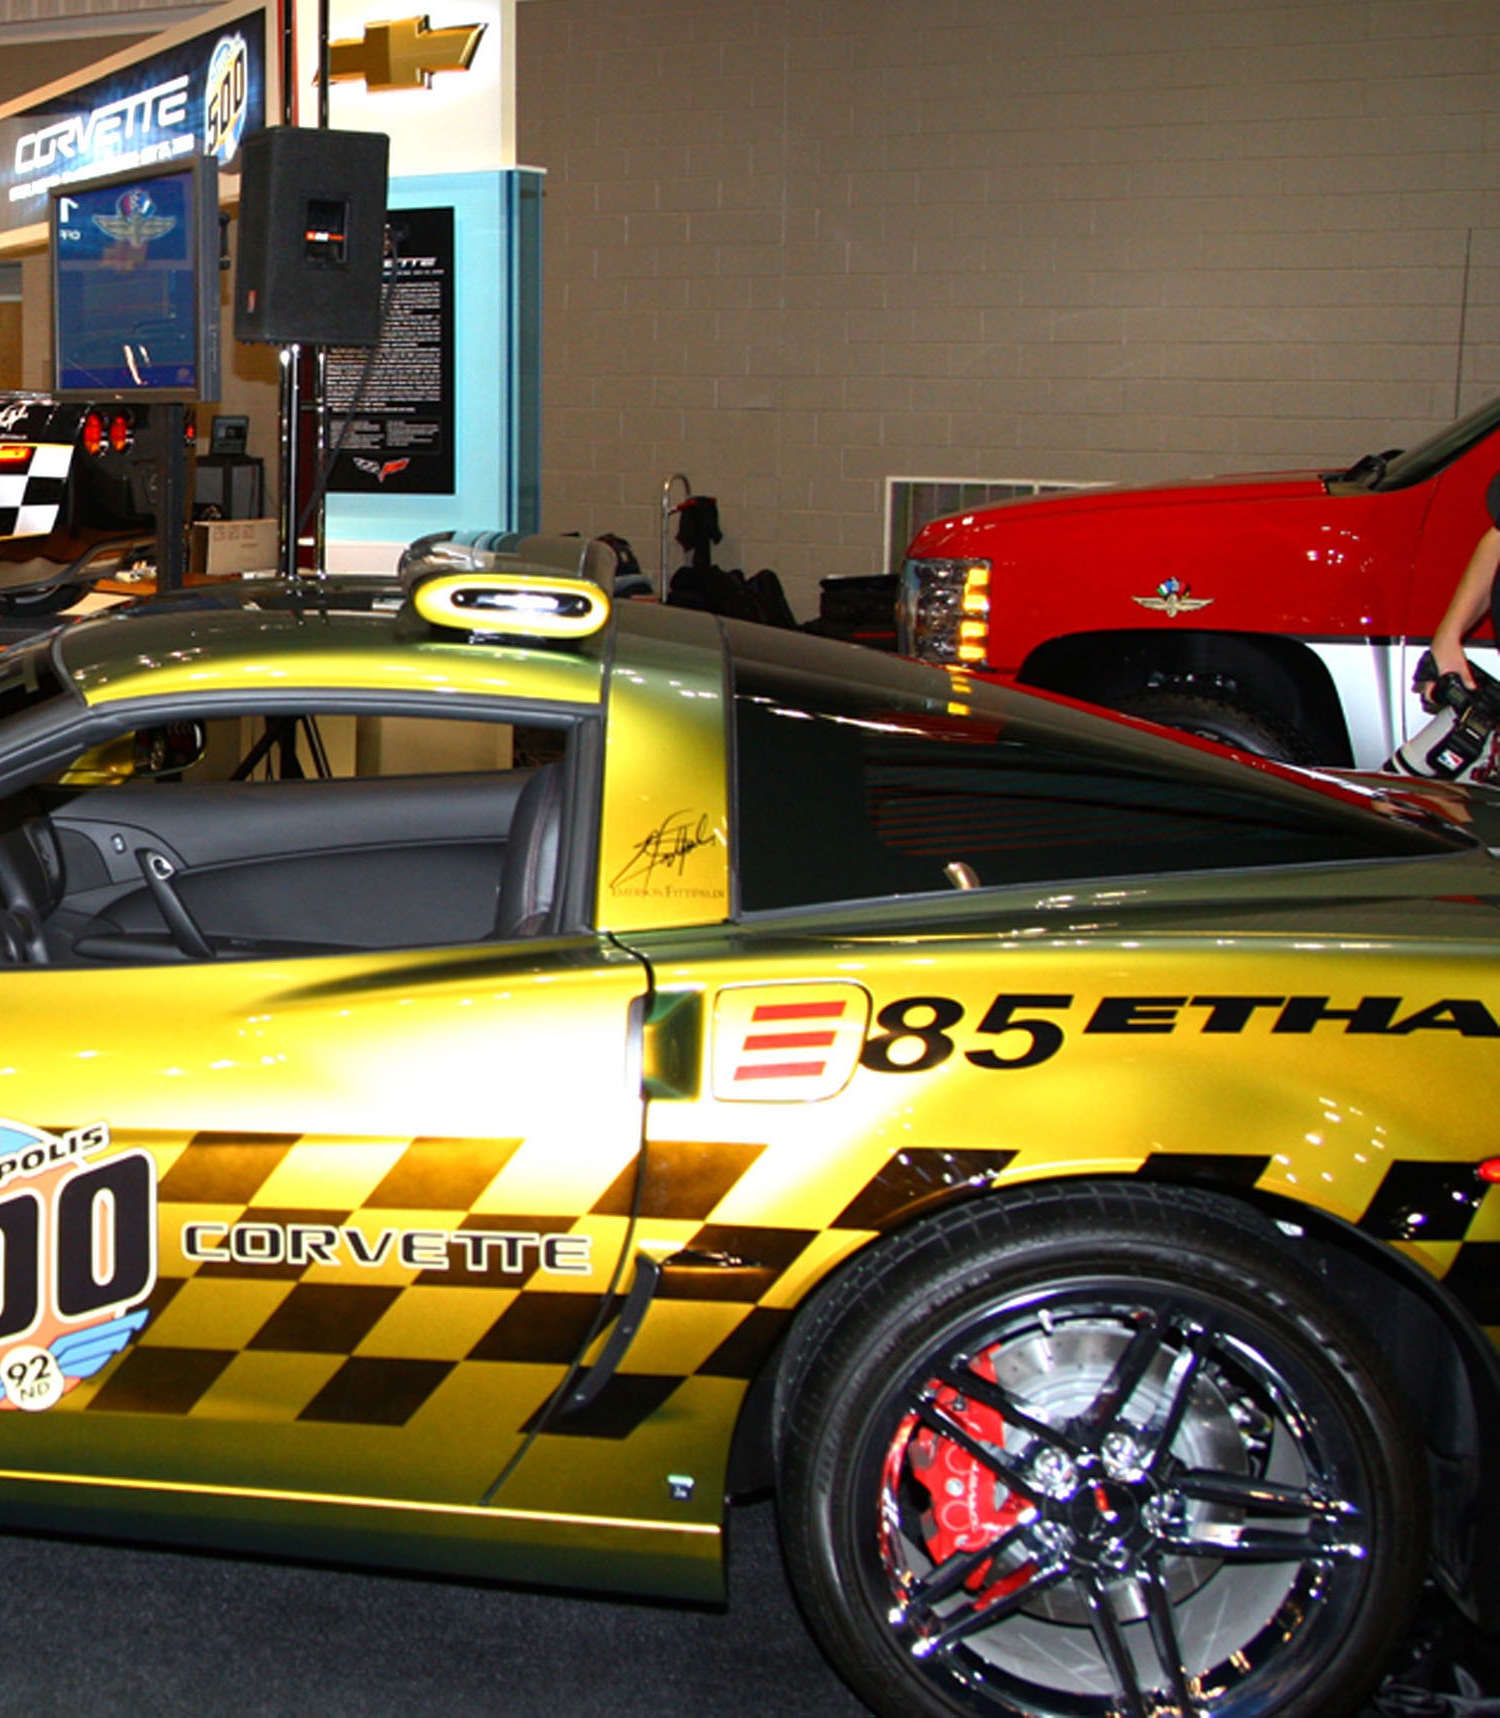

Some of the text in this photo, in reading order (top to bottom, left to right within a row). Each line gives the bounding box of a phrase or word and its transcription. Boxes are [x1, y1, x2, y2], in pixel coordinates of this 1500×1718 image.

[15, 75, 189, 175] CORVETTE
[1083, 996, 1500, 1037] ETHA
[182, 1223, 592, 1275] CORVETTE
[6, 1354, 51, 1389] 92
[19, 1382, 51, 1401] ND
